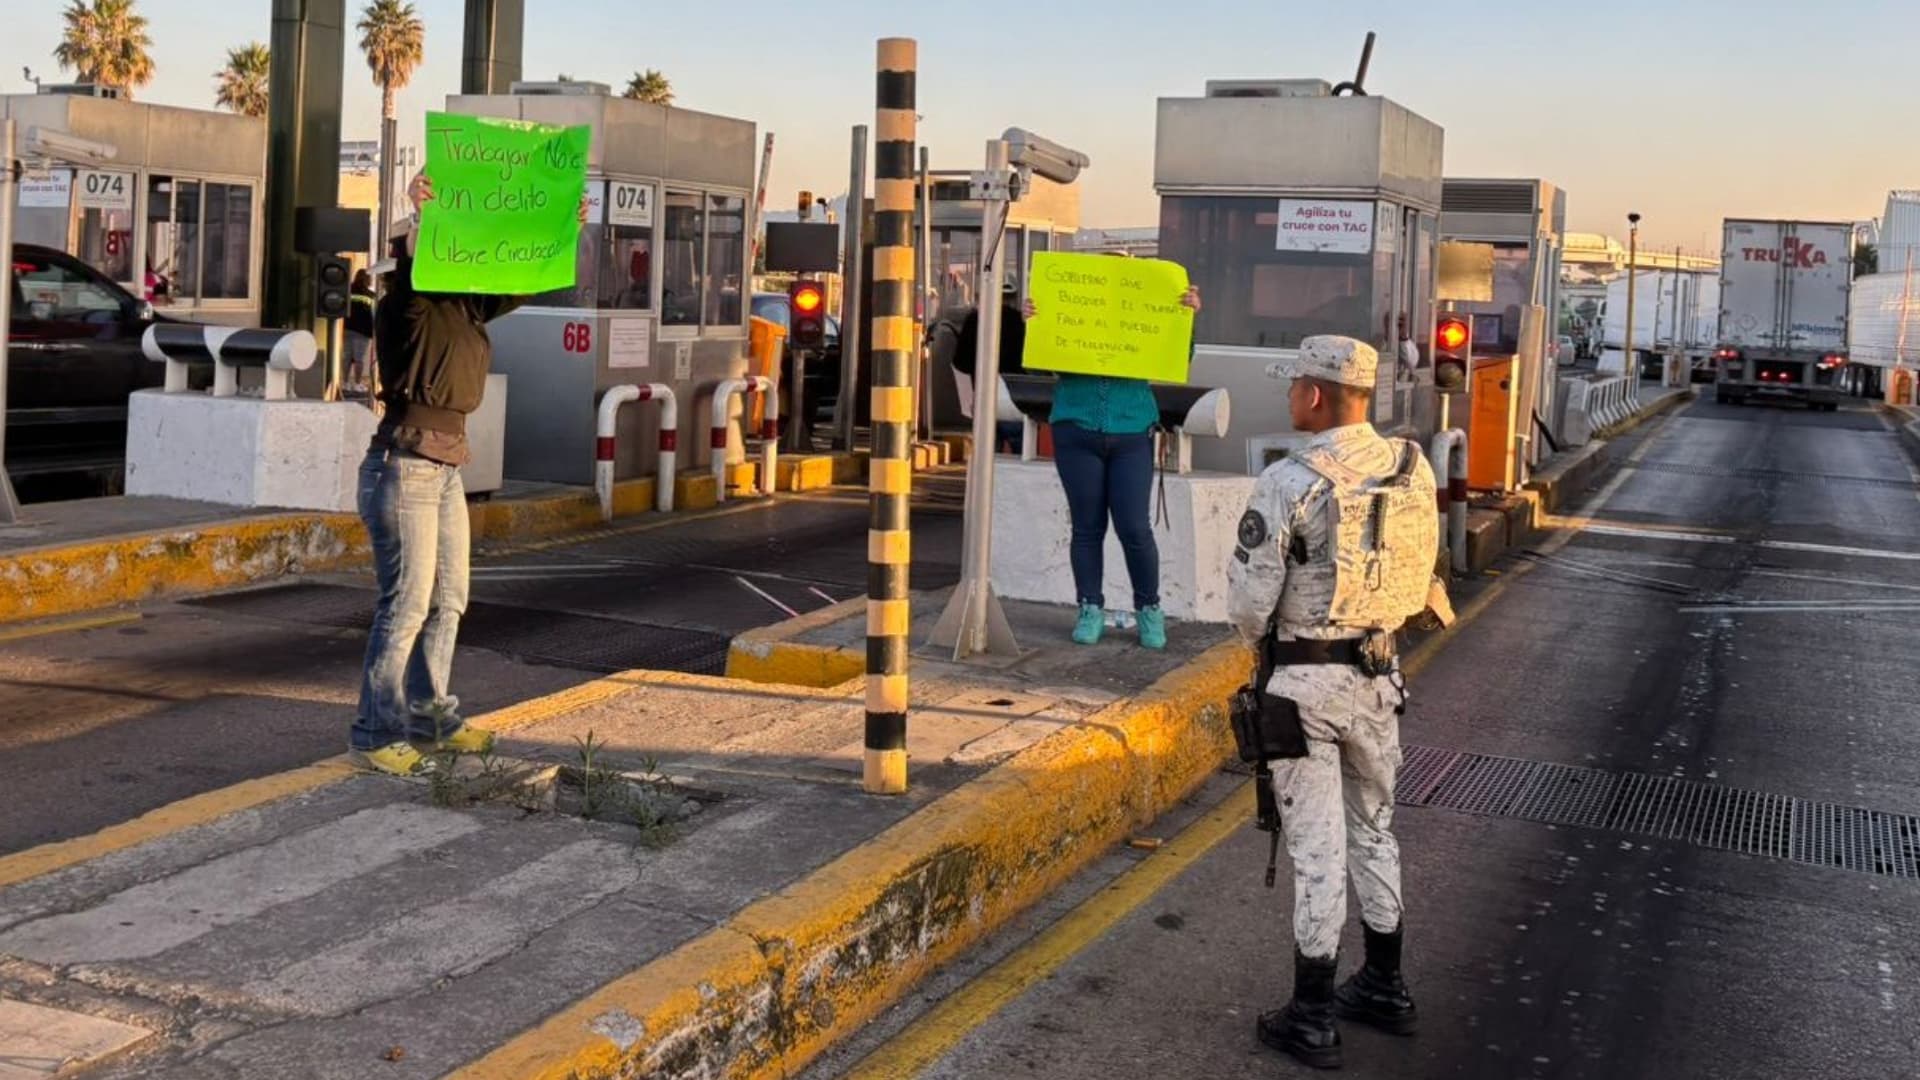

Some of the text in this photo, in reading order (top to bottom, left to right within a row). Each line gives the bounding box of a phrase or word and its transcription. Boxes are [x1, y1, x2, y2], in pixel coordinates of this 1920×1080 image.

[430, 128, 529, 181] Trabajar
[545, 136, 567, 169] No
[86, 174, 123, 194] 074
[484, 184, 547, 211] delito
[617, 186, 646, 210] 074
[1296, 206, 1352, 219] Agiliza tu
[1282, 222, 1368, 232] cruce con TAG
[431, 224, 489, 264] Libre
[563, 322, 590, 352] 6B
